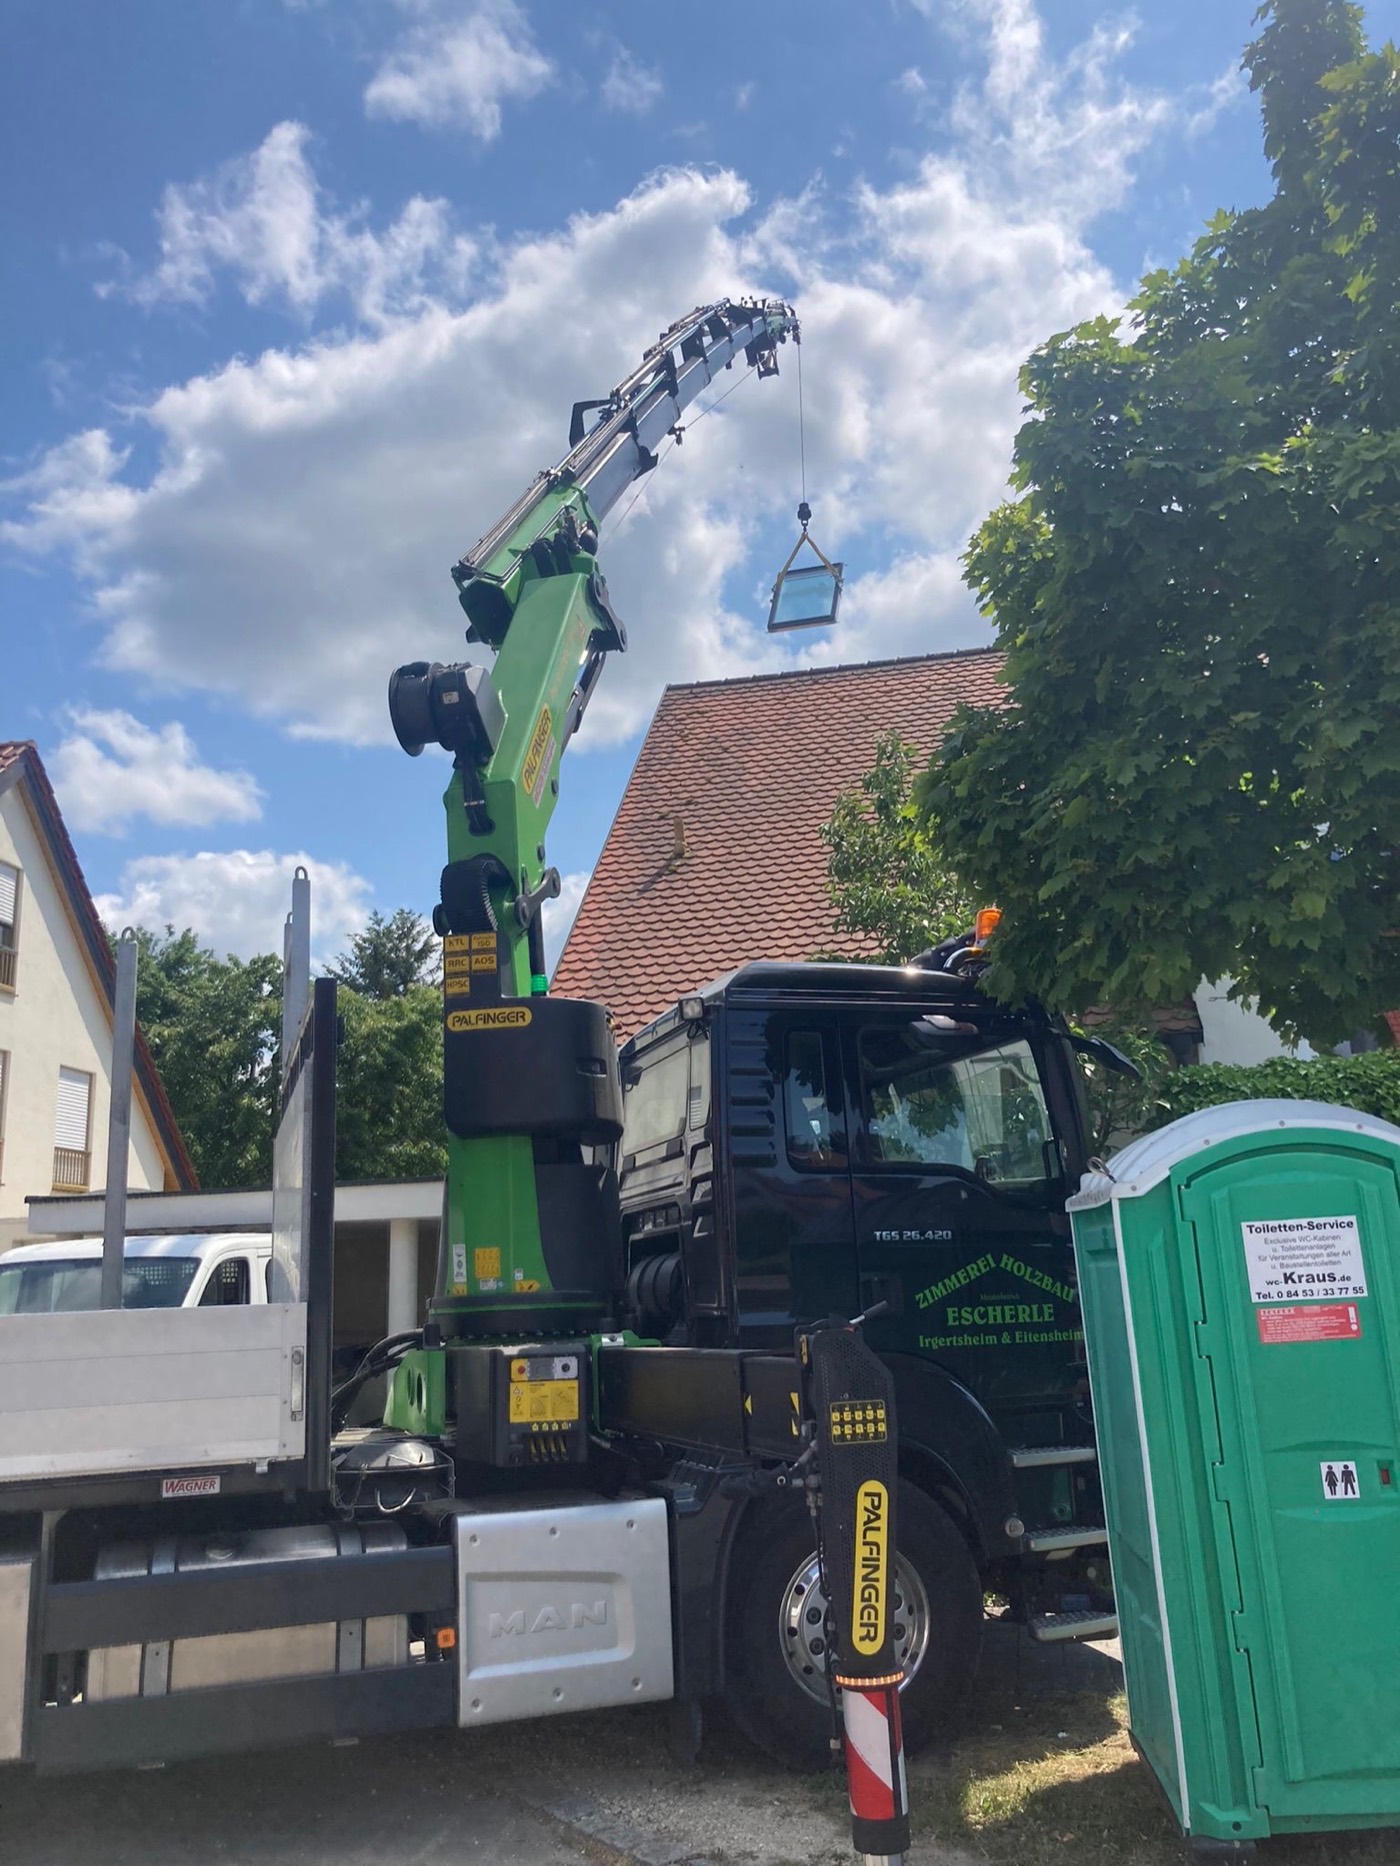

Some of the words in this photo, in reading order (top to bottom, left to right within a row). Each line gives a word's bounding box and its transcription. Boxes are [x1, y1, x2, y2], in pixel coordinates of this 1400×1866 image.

[524, 708, 551, 790] PALFINGER
[448, 959, 466, 968] RRC
[474, 957, 494, 965] AOS
[447, 980, 468, 989] HPSC
[452, 1011, 526, 1027] PALFINGER
[1246, 1220, 1354, 1234] Toiletten-Service
[874, 1230, 900, 1241] TGS
[902, 1229, 952, 1241] 26.420
[1264, 1236, 1297, 1245] Exclusive
[1298, 1233, 1341, 1243] WC-Kabinen
[1281, 1243, 1335, 1253] Toilettenanlagen
[1258, 1254, 1268, 1262] für
[1269, 1252, 1324, 1261] Veranstaltungen
[1326, 1250, 1340, 1258] aller
[1341, 1249, 1351, 1257] Art
[1280, 1261, 1341, 1269] Baustellentoiletten
[915, 1252, 997, 1310] ZIMMEREI
[999, 1252, 1076, 1304] HOLZBAU
[1255, 1290, 1274, 1300] Tel.
[1276, 1290, 1284, 1299] 0
[1286, 1289, 1299, 1299] 84
[1302, 1288, 1314, 1298] 53
[1322, 1287, 1335, 1297] 33
[1337, 1286, 1349, 1296] 77
[1352, 1286, 1365, 1295] 55
[946, 1303, 1055, 1326] ESCHERLE
[919, 1330, 997, 1350] Irgertsheim
[1001, 1331, 1011, 1344] &
[165, 1478, 216, 1493] WAGNER
[859, 1492, 882, 1642] PALFINGER
[489, 1600, 607, 1639] MAN
